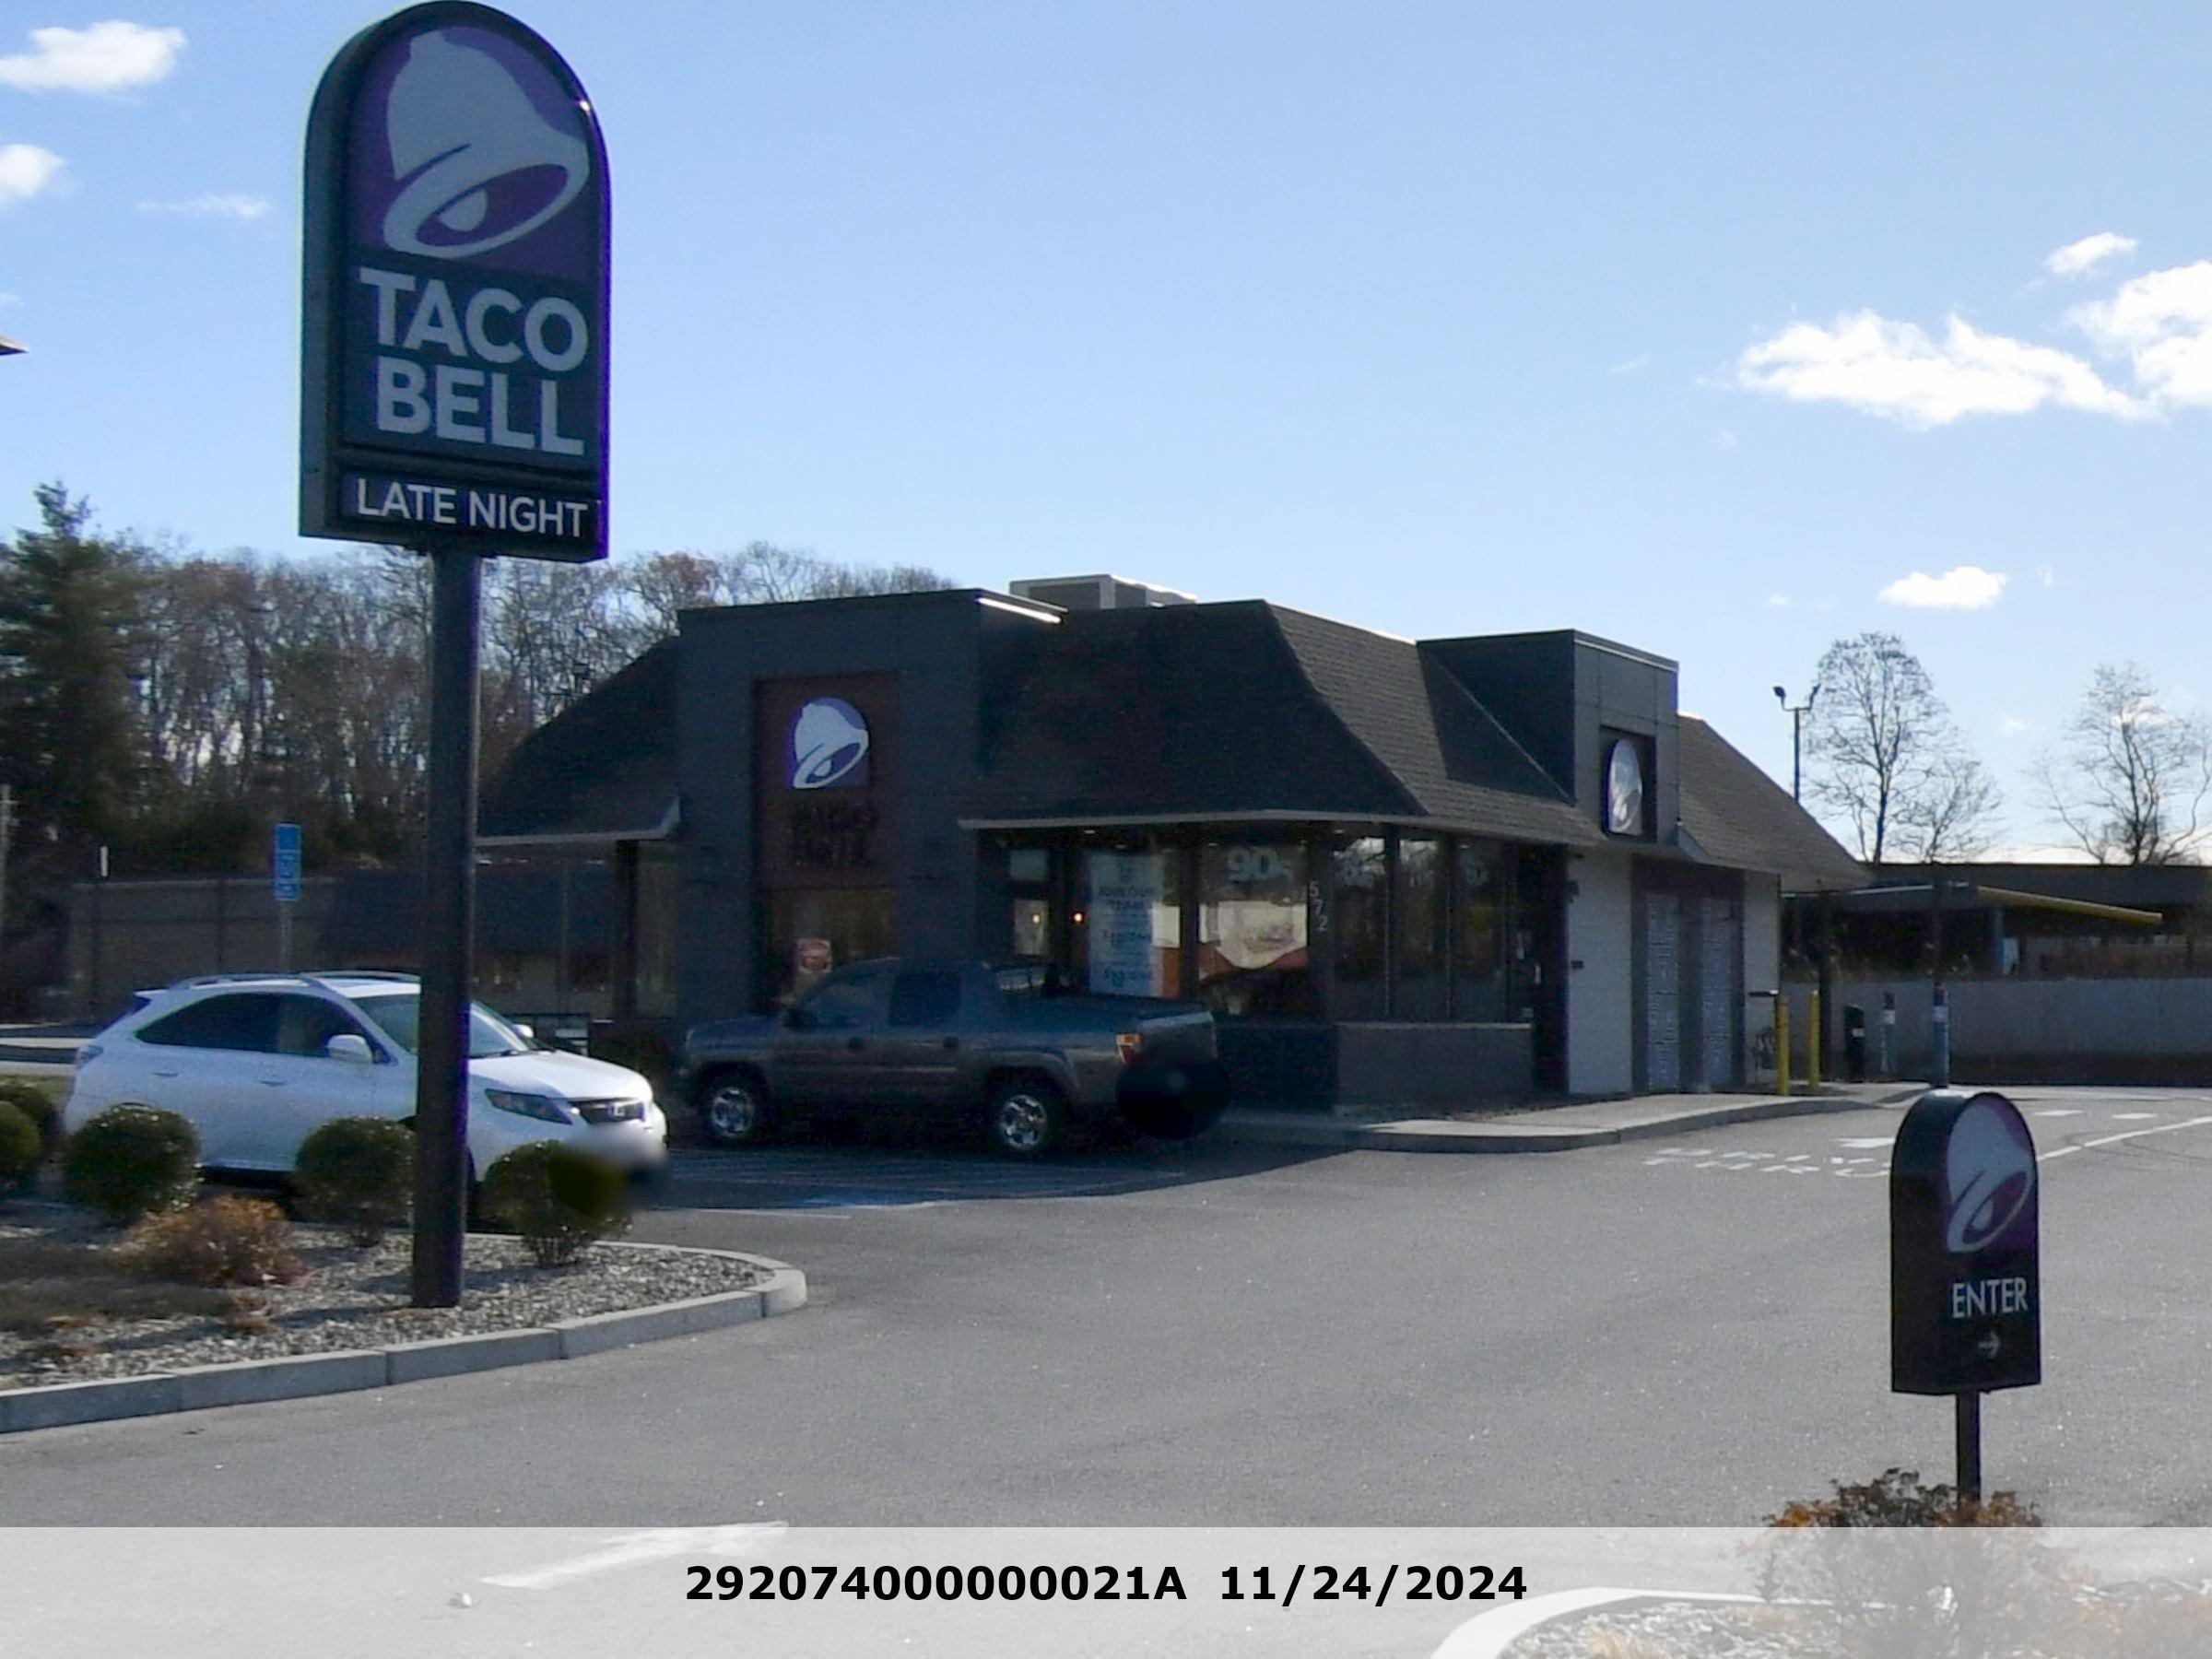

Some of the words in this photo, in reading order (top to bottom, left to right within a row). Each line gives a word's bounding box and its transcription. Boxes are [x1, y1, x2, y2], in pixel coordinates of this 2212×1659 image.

[359, 266, 589, 372] TACO
[376, 356, 584, 455] BELL
[357, 477, 457, 524] LATE
[468, 490, 588, 537] NIGHT
[1951, 1277, 2028, 1318] ENTER
